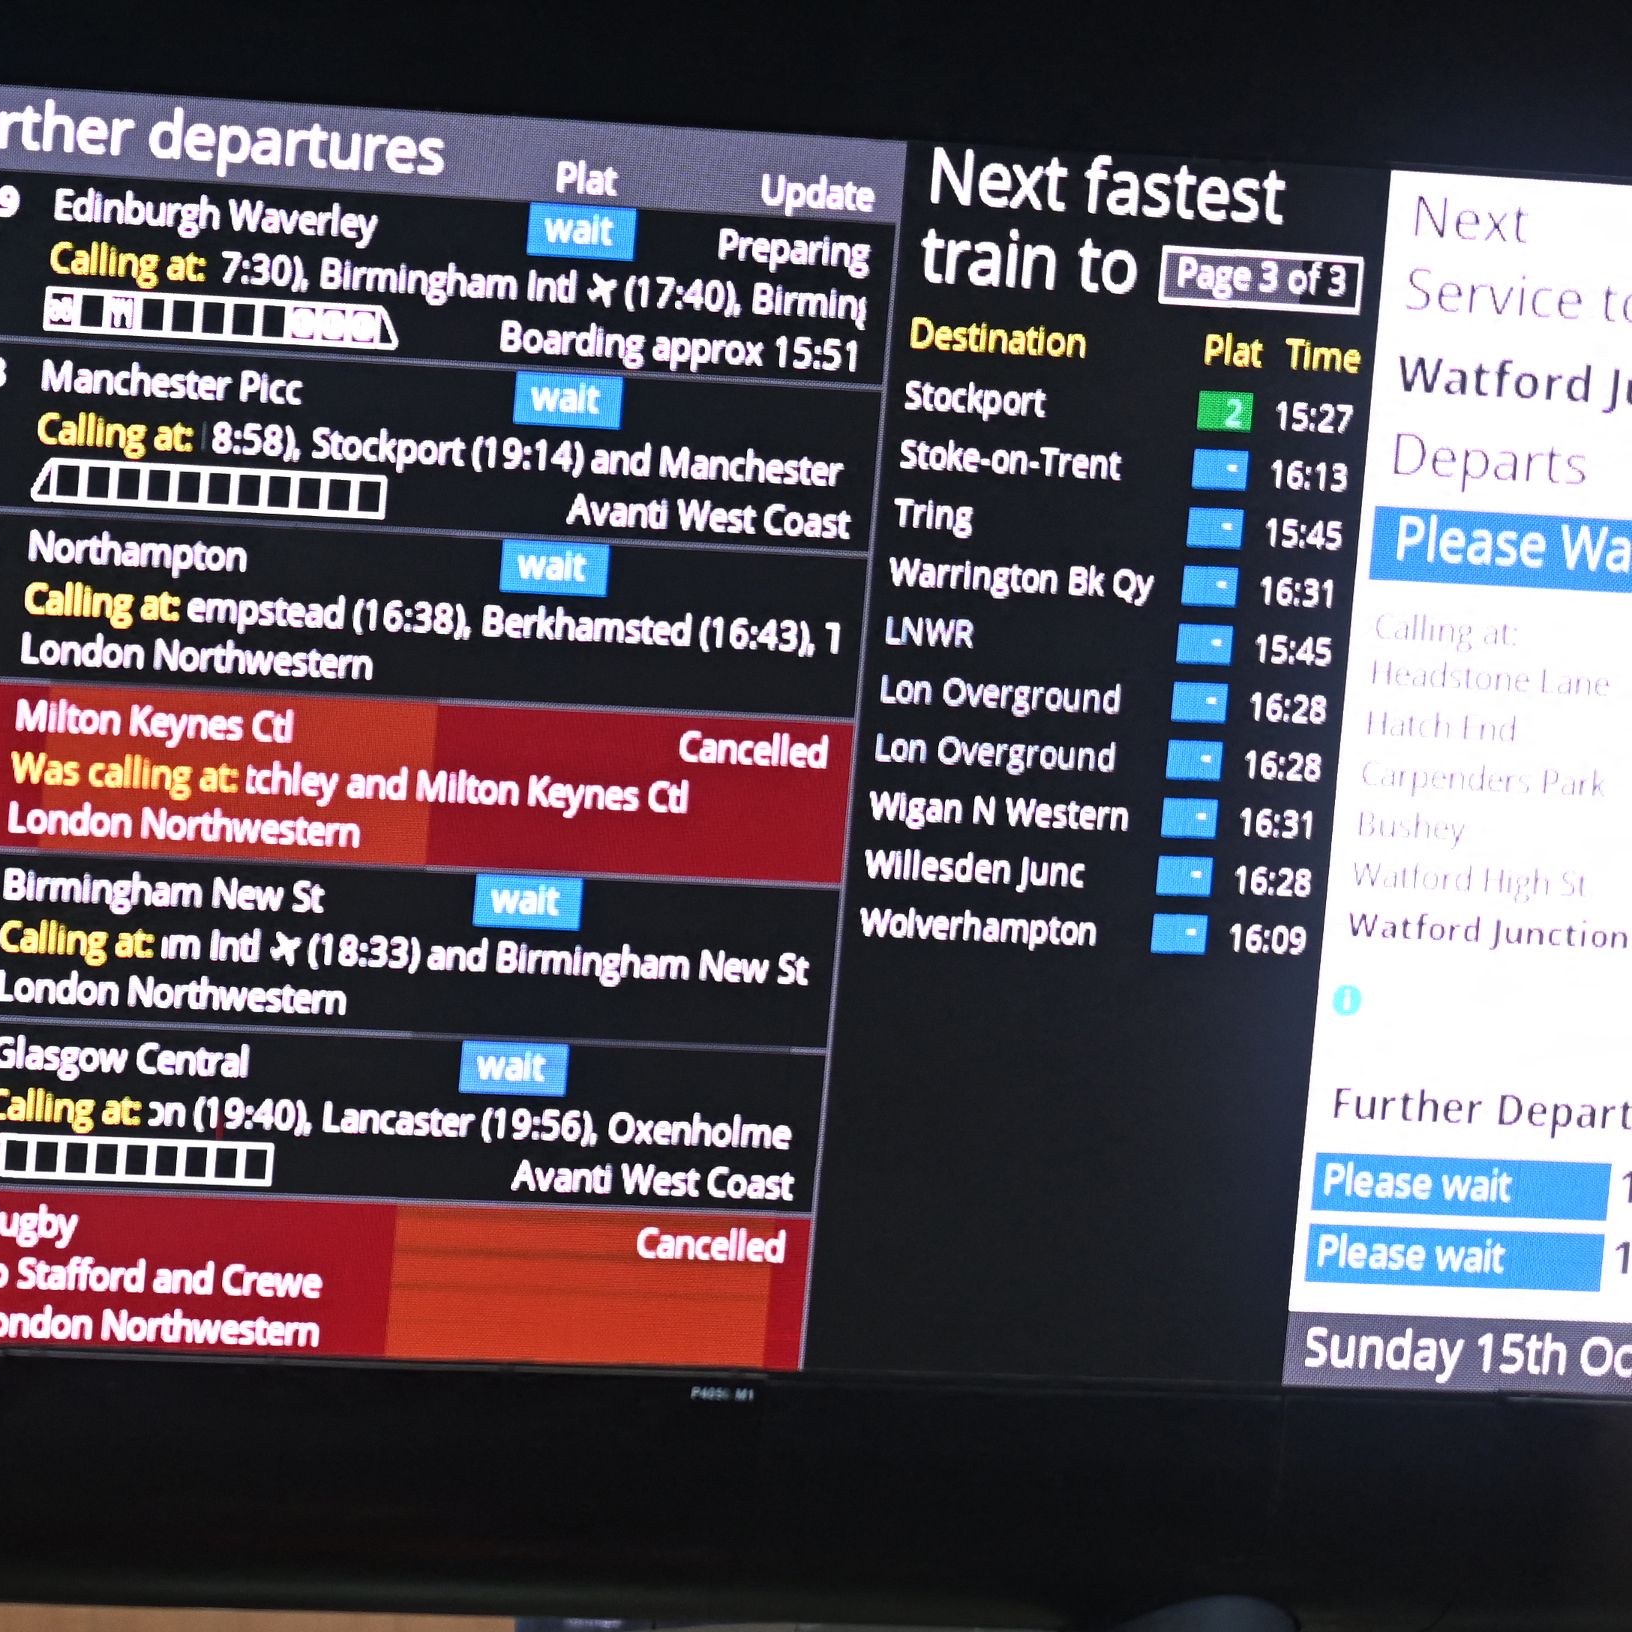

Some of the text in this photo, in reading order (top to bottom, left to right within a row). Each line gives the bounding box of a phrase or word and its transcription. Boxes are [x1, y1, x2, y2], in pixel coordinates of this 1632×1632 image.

[149, 107, 444, 177] departures
[557, 161, 617, 195] Plat
[762, 174, 874, 215] Update
[930, 146, 1286, 225] Next fastest
[54, 188, 221, 239] Edinburgh
[228, 199, 378, 249] Waverley
[543, 214, 615, 248] wait
[1414, 195, 1528, 244] Next
[718, 228, 871, 279] Preparing
[921, 228, 1138, 295] train to
[1178, 254, 1345, 298] Page 3 of 3
[1406, 268, 1583, 320] Service
[500, 319, 858, 372] Boarding approx 15:51
[910, 316, 1361, 374] Destination Plat Time
[41, 359, 232, 401] Manchester
[239, 369, 303, 405] Picc
[1399, 355, 1592, 402] Watford
[904, 380, 1354, 433] Stockport 2 15:27
[900, 439, 1348, 492] Stoke-on-Trent 16:13
[566, 493, 851, 540] Avanti West Coast
[1396, 514, 1547, 569] Please
[885, 617, 1332, 667] LNWR 15:45
[1371, 660, 1611, 697] Headstone Lane
[15, 698, 122, 736] Milton
[129, 704, 244, 749] Keynes
[251, 709, 294, 744] Ctl
[679, 730, 829, 769] Cancelled
[8, 801, 361, 848] London Northwestern
[3, 867, 203, 915] Birmingham
[212, 877, 285, 911] New
[292, 880, 325, 914] St
[865, 849, 1312, 898] Willesden Junc 16:28
[860, 907, 1307, 955] Wolverhampton 16:09
[1348, 911, 1629, 950] Watford Junction
[136, 1042, 250, 1078] Central
[1333, 1087, 1483, 1124] Further
[1323, 1161, 1514, 1204] Please wait
[17, 1256, 146, 1293] Stafford
[152, 1261, 215, 1295] and
[222, 1263, 323, 1299] Crewe
[1304, 1326, 1568, 1384] Sunday 15th
